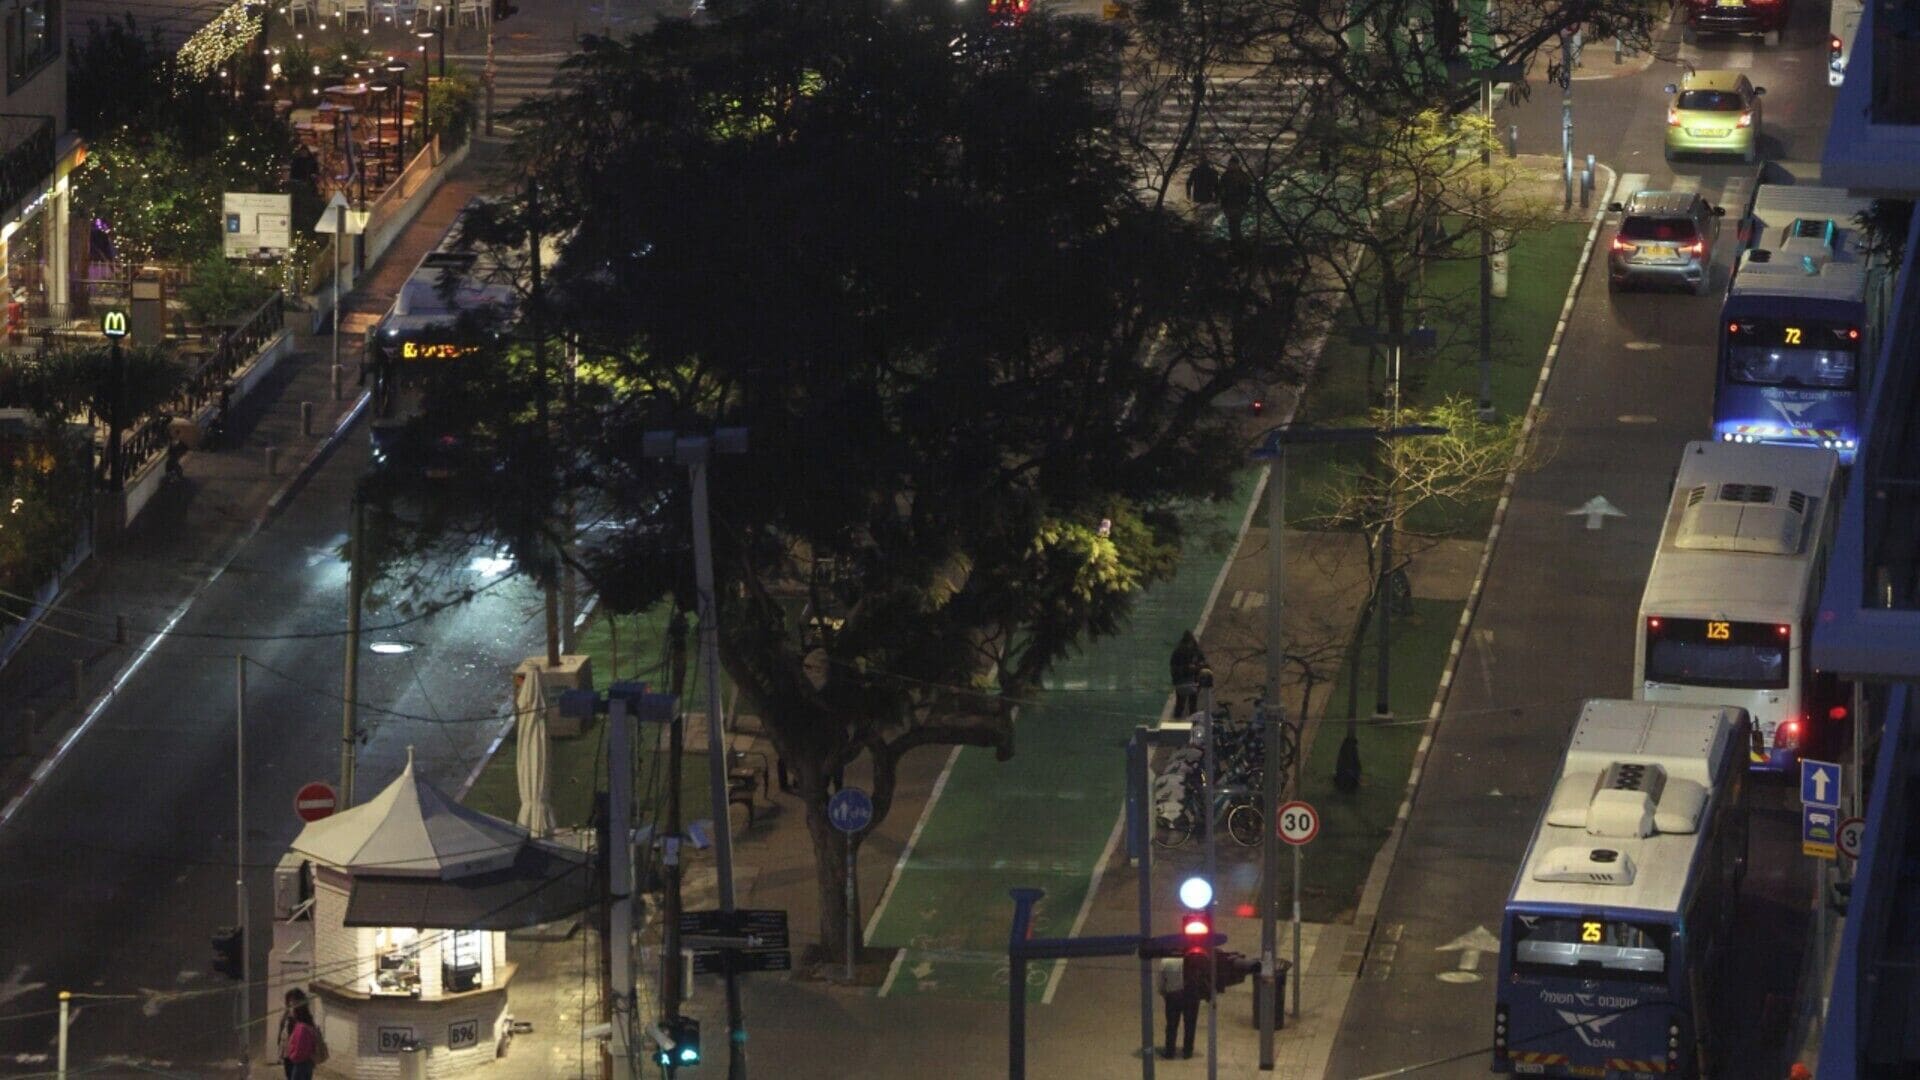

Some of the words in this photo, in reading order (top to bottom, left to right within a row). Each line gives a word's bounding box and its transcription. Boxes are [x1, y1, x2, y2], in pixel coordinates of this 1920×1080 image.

[1784, 327, 1802, 345] 72
[1795, 421, 1813, 429] DAN
[1706, 622, 1731, 640] 125
[1284, 812, 1311, 832] 30
[1581, 922, 1602, 942] 25
[382, 1032, 408, 1047] B96
[452, 1025, 474, 1044] B96
[1592, 1039, 1616, 1049] DAN
